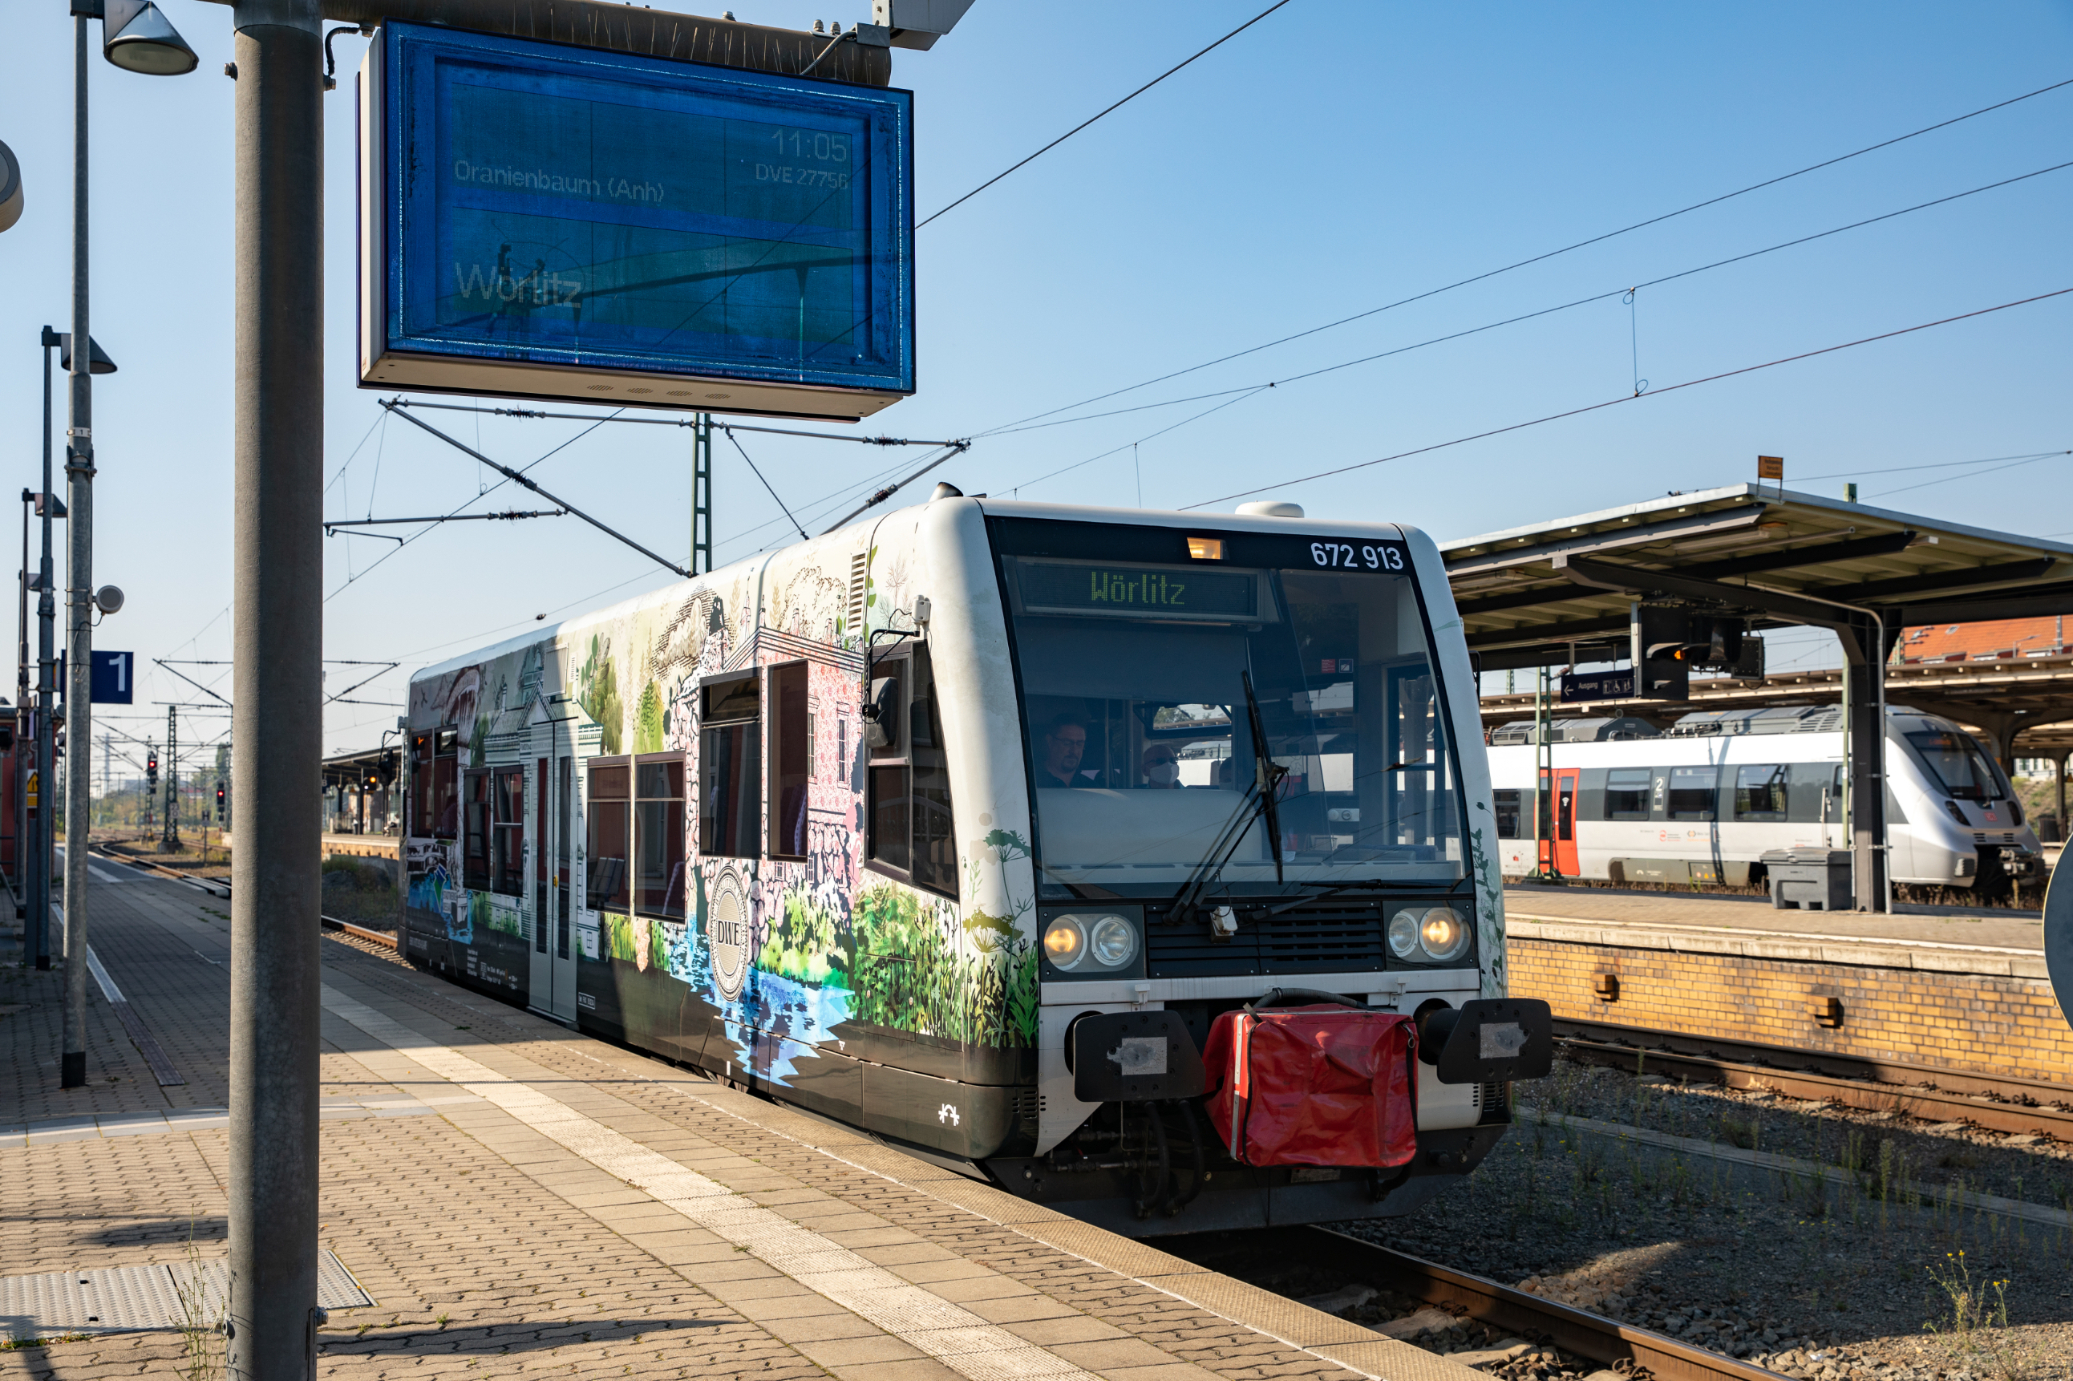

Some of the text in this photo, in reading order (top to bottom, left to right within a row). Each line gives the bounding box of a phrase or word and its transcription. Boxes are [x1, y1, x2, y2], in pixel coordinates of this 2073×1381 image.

[771, 128, 847, 162] 11:05
[454, 159, 665, 203] Oranienbaum (Anh)
[755, 163, 848, 190] DVE 27756
[454, 262, 582, 309] Wörlitz
[1310, 542, 1404, 571] 672 913
[1091, 571, 1185, 605] Wörlitz
[108, 653, 127, 693] 1
[1578, 682, 1599, 691] Ausgang
[1655, 777, 1664, 792] 2
[717, 920, 740, 947] DWE
